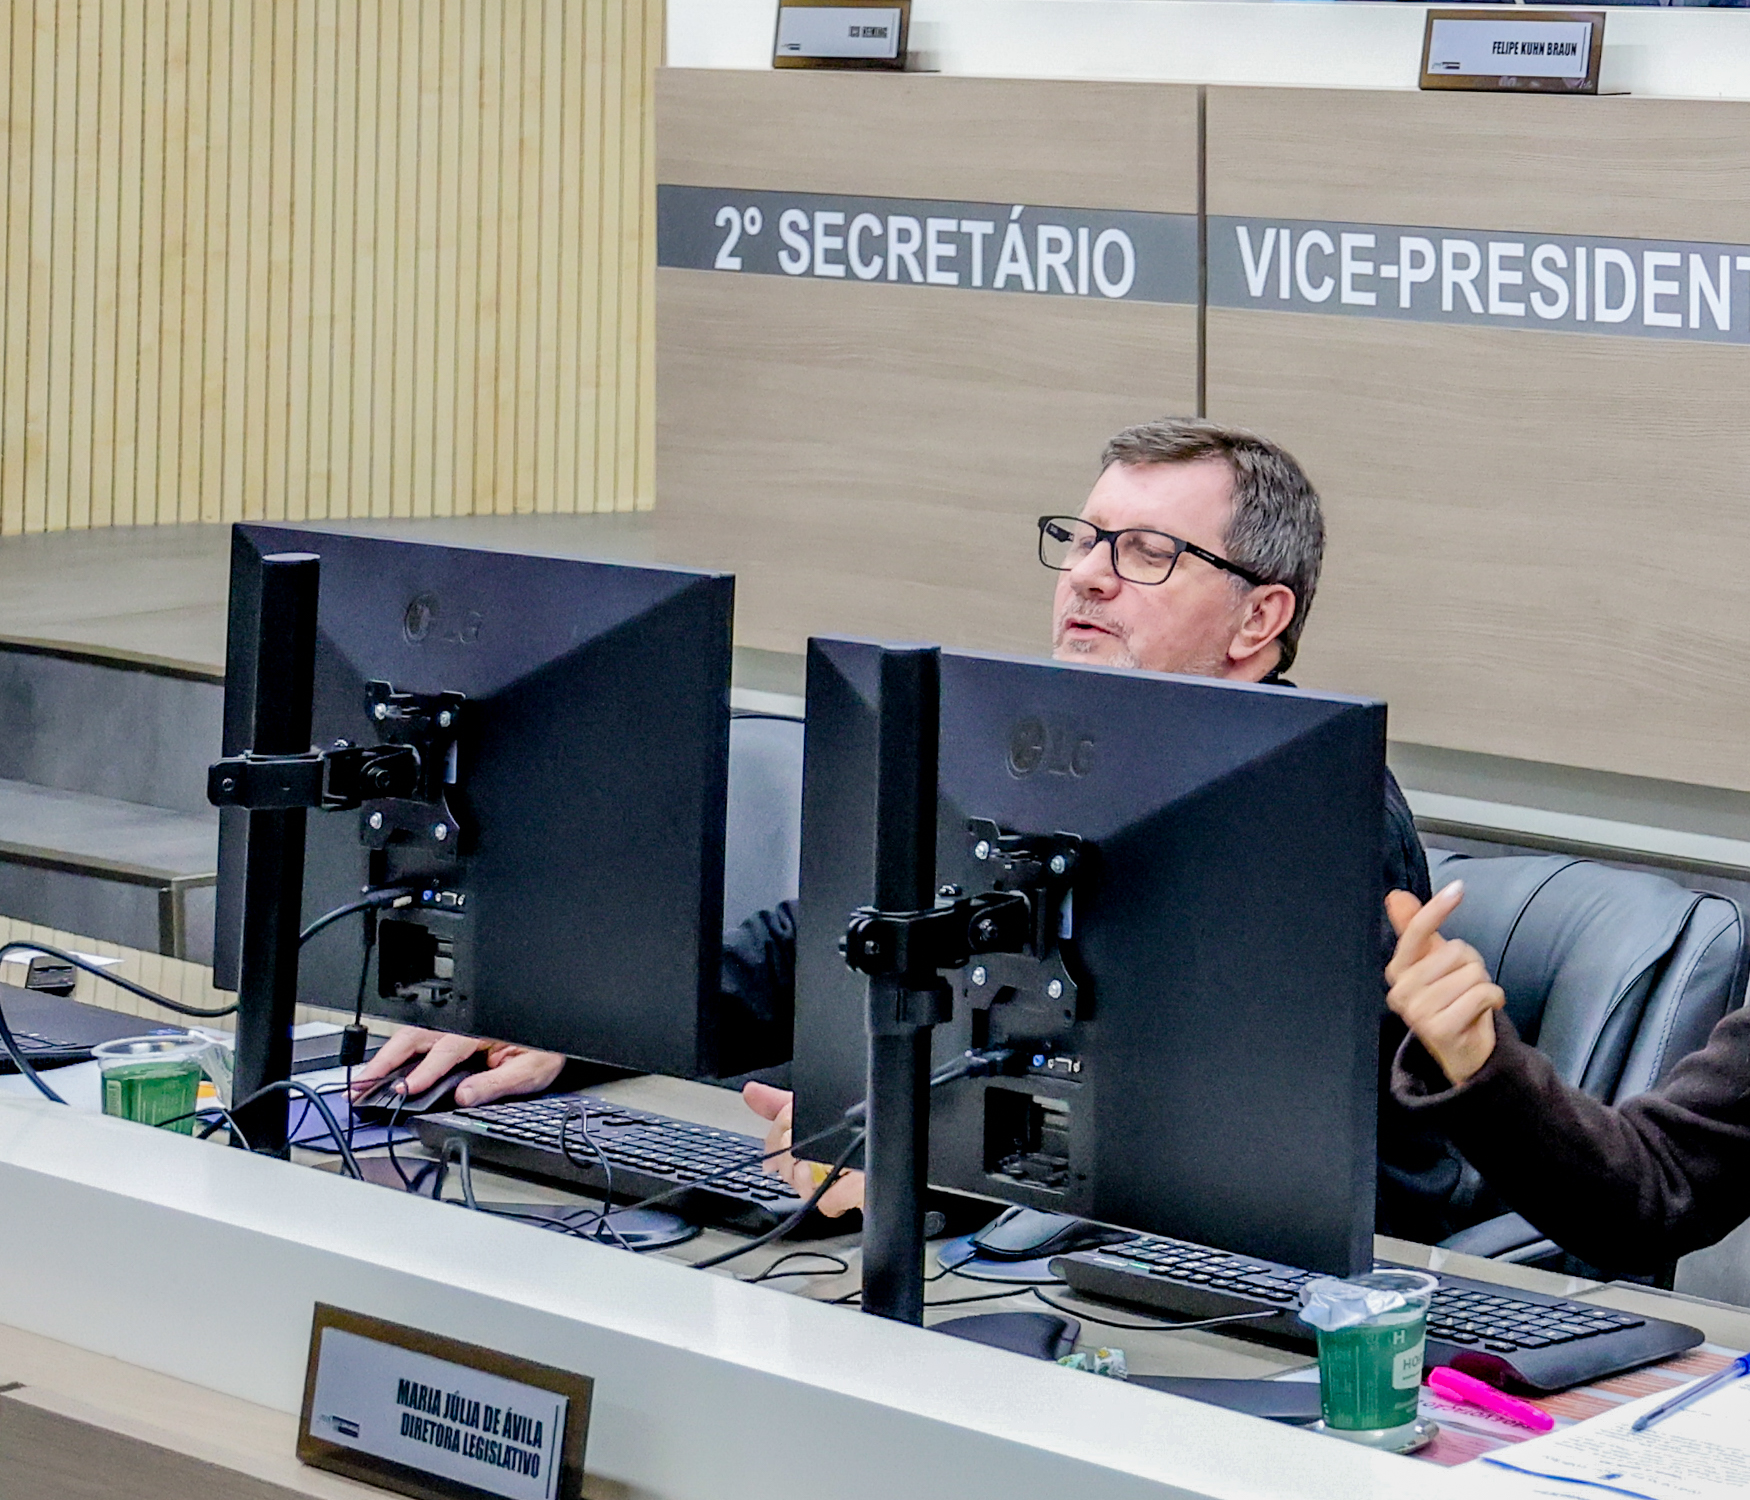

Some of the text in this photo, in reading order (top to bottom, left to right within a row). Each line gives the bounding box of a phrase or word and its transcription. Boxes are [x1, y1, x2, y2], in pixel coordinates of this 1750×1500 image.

[1492, 41, 1578, 57] FELIPE KUHN BRAUN
[713, 204, 1136, 299] 2º SECRETÁRIO
[396, 1378, 543, 1449] MARIA JÚLIA DE ÁVILA
[400, 1412, 460, 1453] DIRETORA
[462, 1432, 541, 1479] LEGISLATIVO
